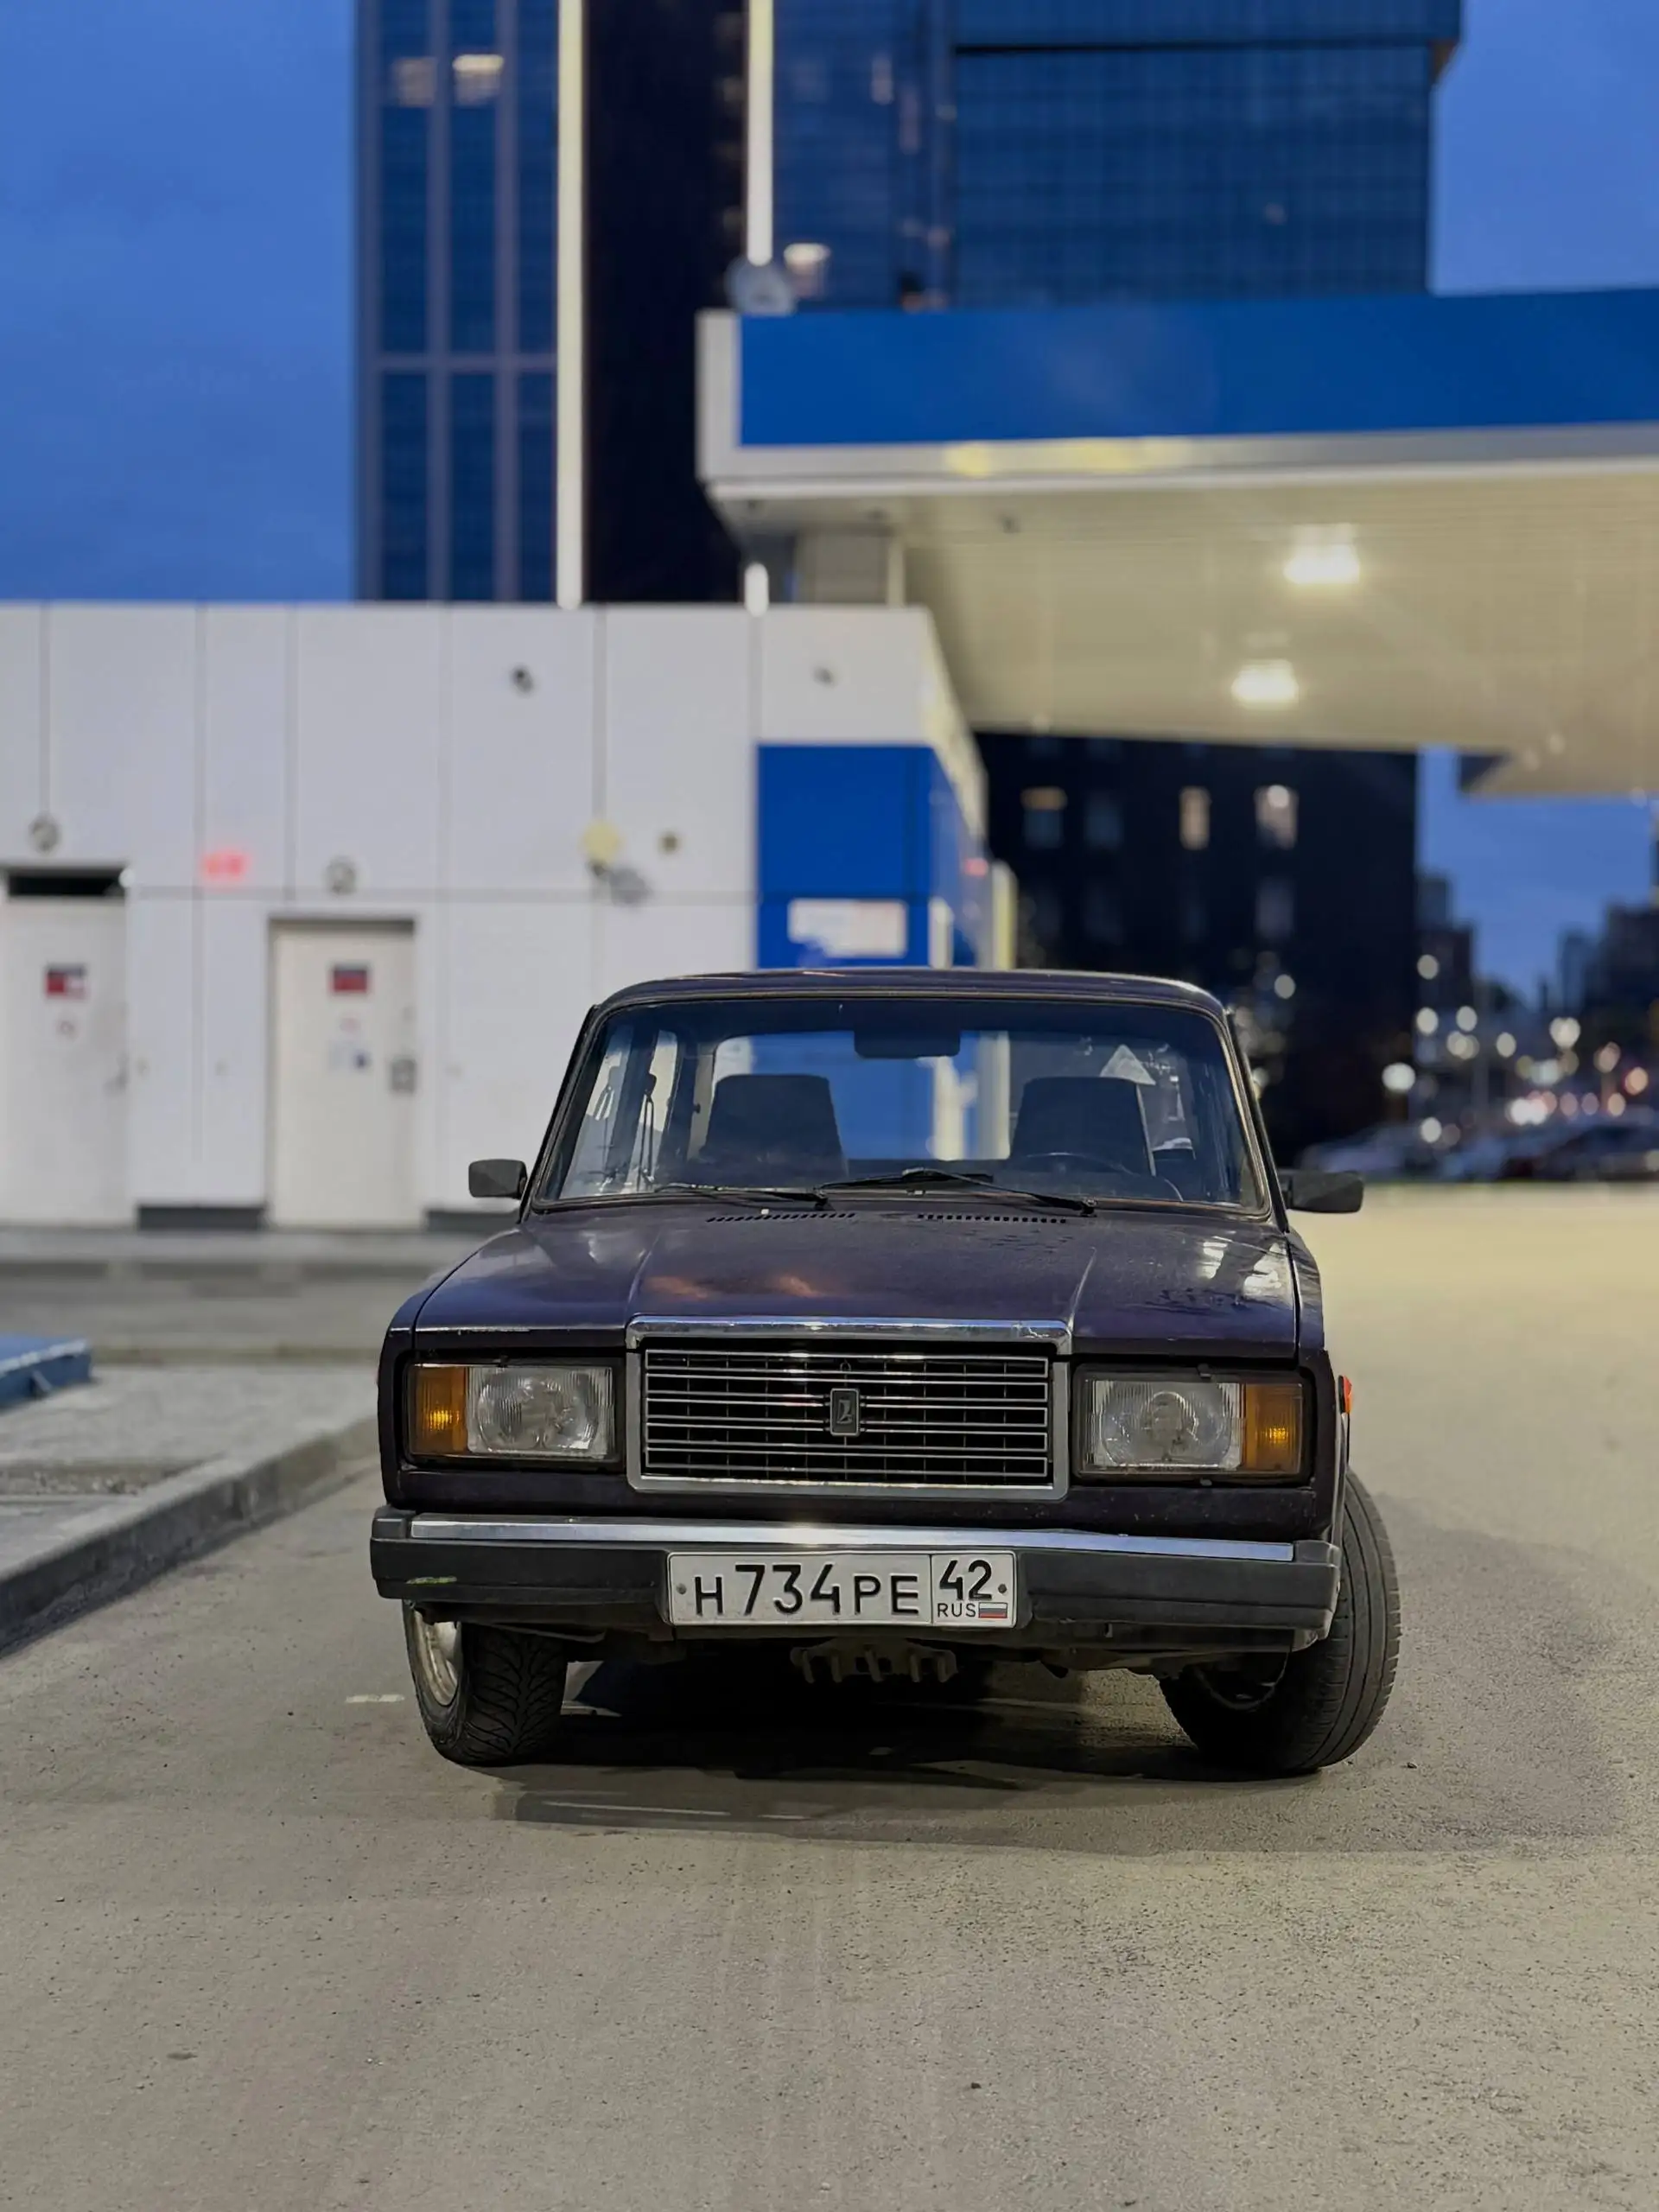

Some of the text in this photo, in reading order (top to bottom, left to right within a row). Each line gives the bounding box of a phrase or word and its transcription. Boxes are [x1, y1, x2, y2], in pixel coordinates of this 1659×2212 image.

[694, 1563, 919, 1617] Н734РЕ
[938, 1559, 993, 1601] 42
[937, 1602, 976, 1618] RUS
